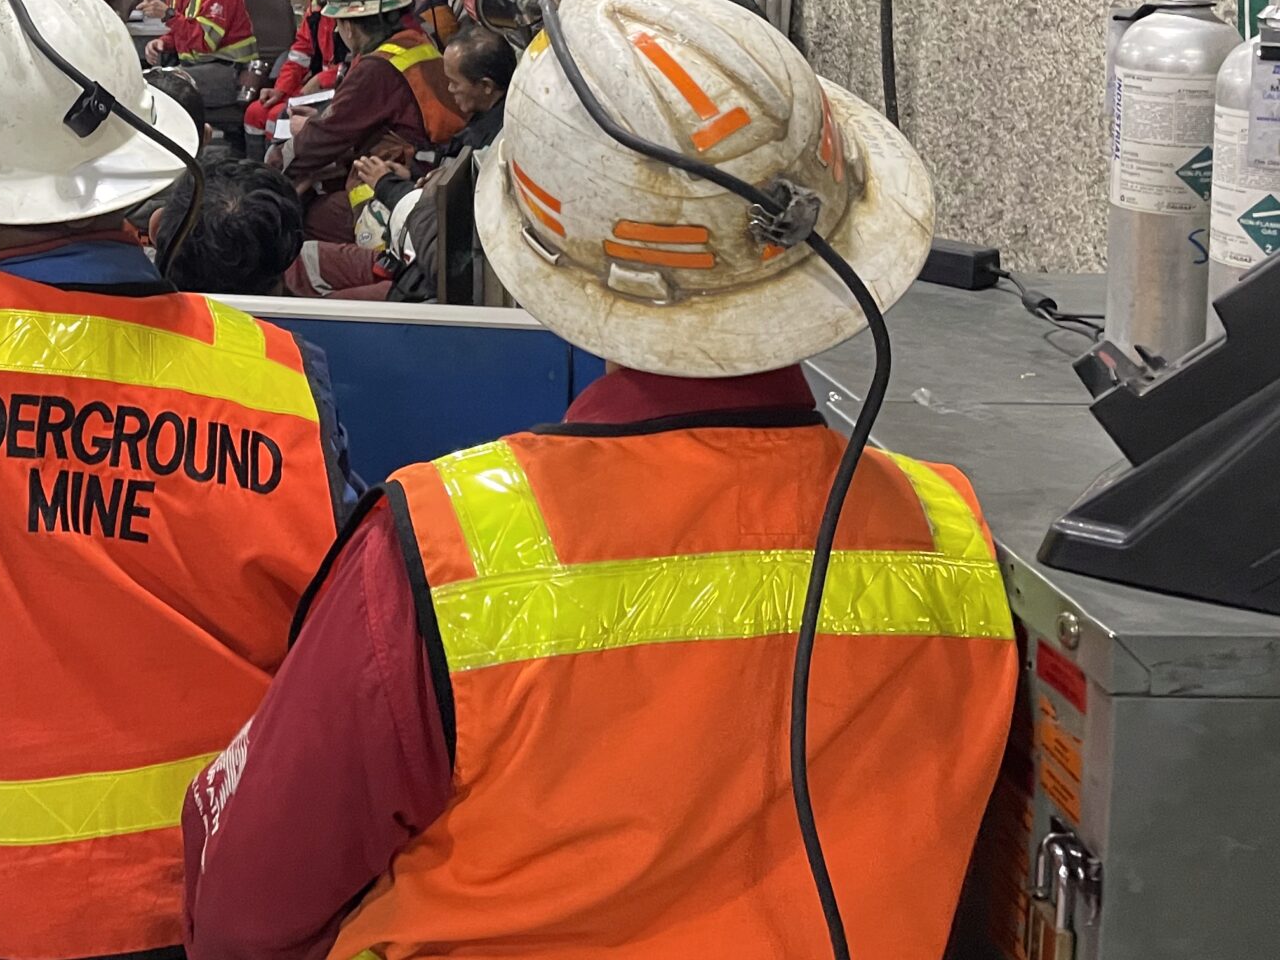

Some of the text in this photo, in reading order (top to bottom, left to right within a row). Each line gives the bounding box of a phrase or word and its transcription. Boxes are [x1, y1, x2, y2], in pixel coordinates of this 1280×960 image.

[1114, 78, 1122, 160] INDUSTRIAL
[1261, 228, 1278, 236] GAS
[1266, 244, 1273, 254] 2
[28, 468, 156, 544] MINE
